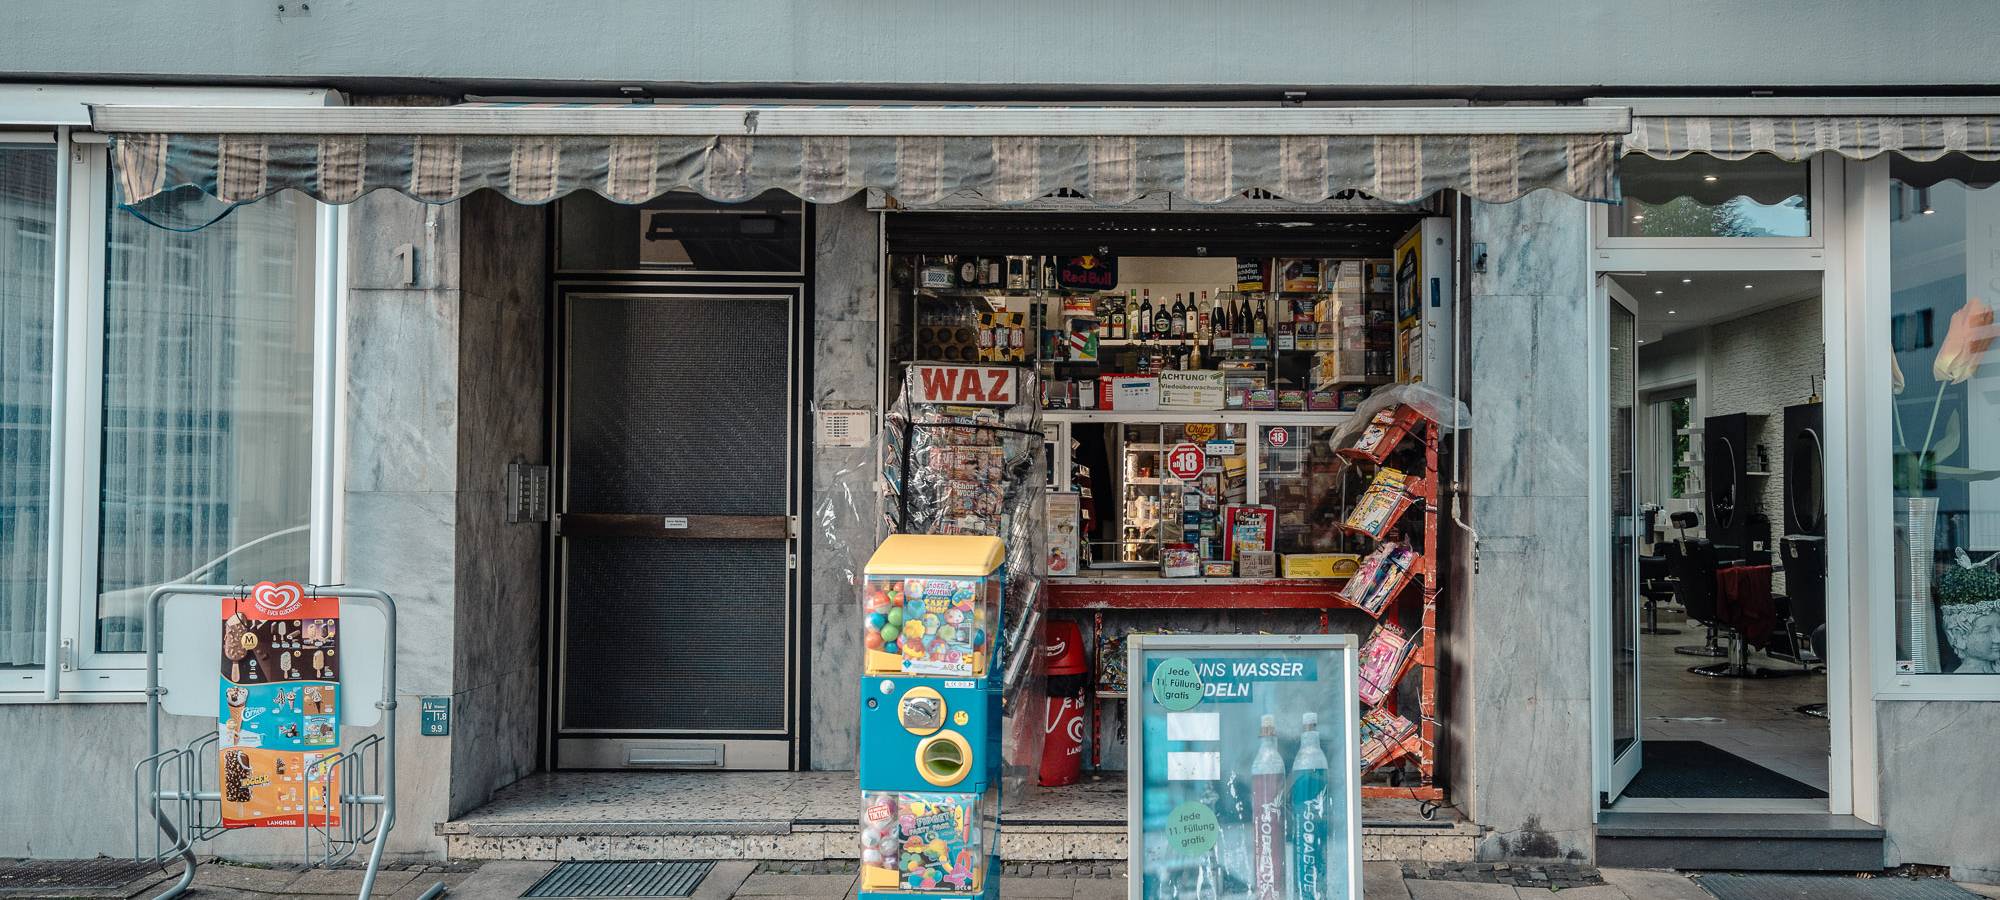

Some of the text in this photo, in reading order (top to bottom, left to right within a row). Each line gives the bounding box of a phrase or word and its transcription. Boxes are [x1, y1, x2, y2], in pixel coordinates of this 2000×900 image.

[394, 243, 413, 284] 1
[1063, 270, 1111, 285] Red Bull
[1161, 373, 1207, 381] ACHTUNG!
[921, 368, 1009, 401] WAZ
[1176, 453, 1197, 471] 18
[1167, 667, 1190, 676] Jede
[1232, 662, 1304, 677] WASSER
[1170, 680, 1201, 690] Füllung
[1165, 691, 1189, 700] gratis
[1179, 812, 1201, 822] Jede
[1183, 823, 1215, 833] Füllung
[1181, 835, 1205, 848] gratis
